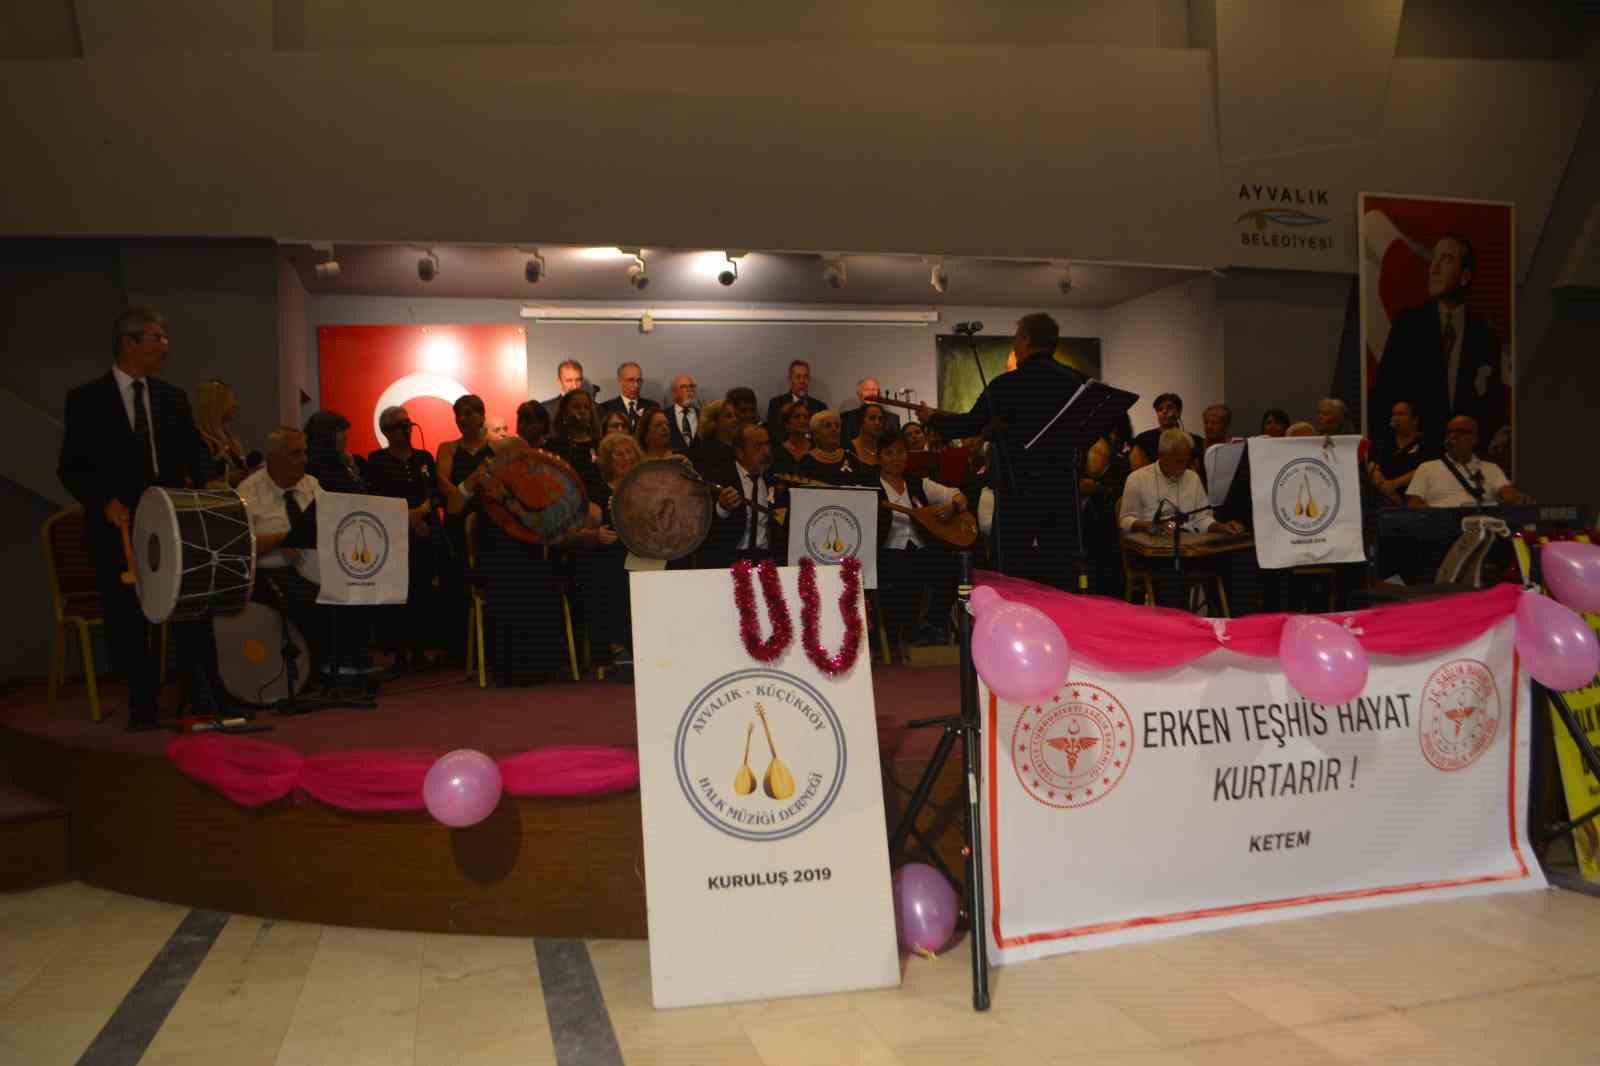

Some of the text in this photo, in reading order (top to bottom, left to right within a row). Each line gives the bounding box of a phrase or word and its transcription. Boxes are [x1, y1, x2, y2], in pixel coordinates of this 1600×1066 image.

[1239, 183, 1328, 205] AYVALIK
[1241, 232, 1332, 250] BELEDİYESİ
[693, 689, 743, 735] AYVALIK
[756, 684, 826, 732] KÜÇÜKKÖY
[1143, 707, 1231, 748] ERKEN
[1236, 696, 1328, 748] TEŞHİS
[1337, 693, 1412, 734] HAYAT
[1214, 758, 1341, 802] KURTARIR
[698, 772, 823, 826] HALK MÜZİĞİ DERNEĞİ
[1249, 830, 1311, 853] KETEM
[708, 867, 832, 890] KURULUŞ 2019
